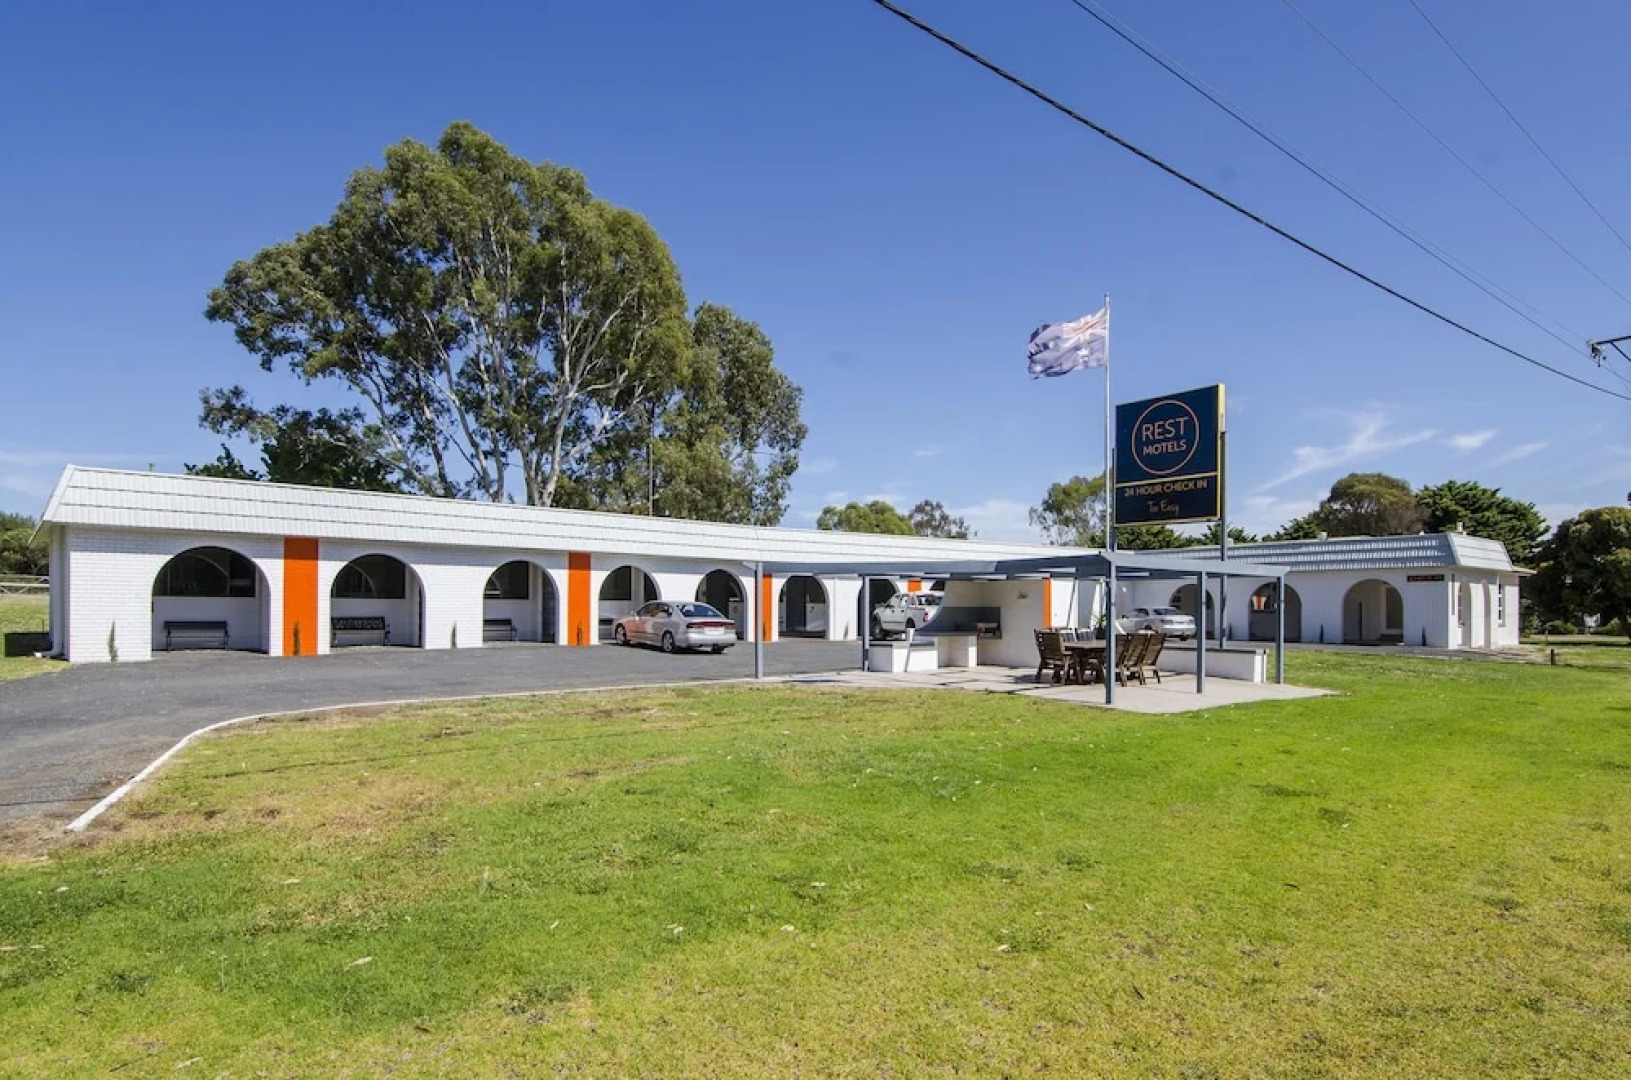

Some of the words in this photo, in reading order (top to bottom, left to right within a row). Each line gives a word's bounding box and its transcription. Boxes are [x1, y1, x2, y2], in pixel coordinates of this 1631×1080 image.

[1142, 417, 1189, 441] REST
[1143, 439, 1187, 456] MOTELS
[1124, 487, 1134, 497] 24
[1136, 484, 1162, 495] HOUR
[1164, 481, 1195, 493] CHECK
[1196, 479, 1208, 489] IN
